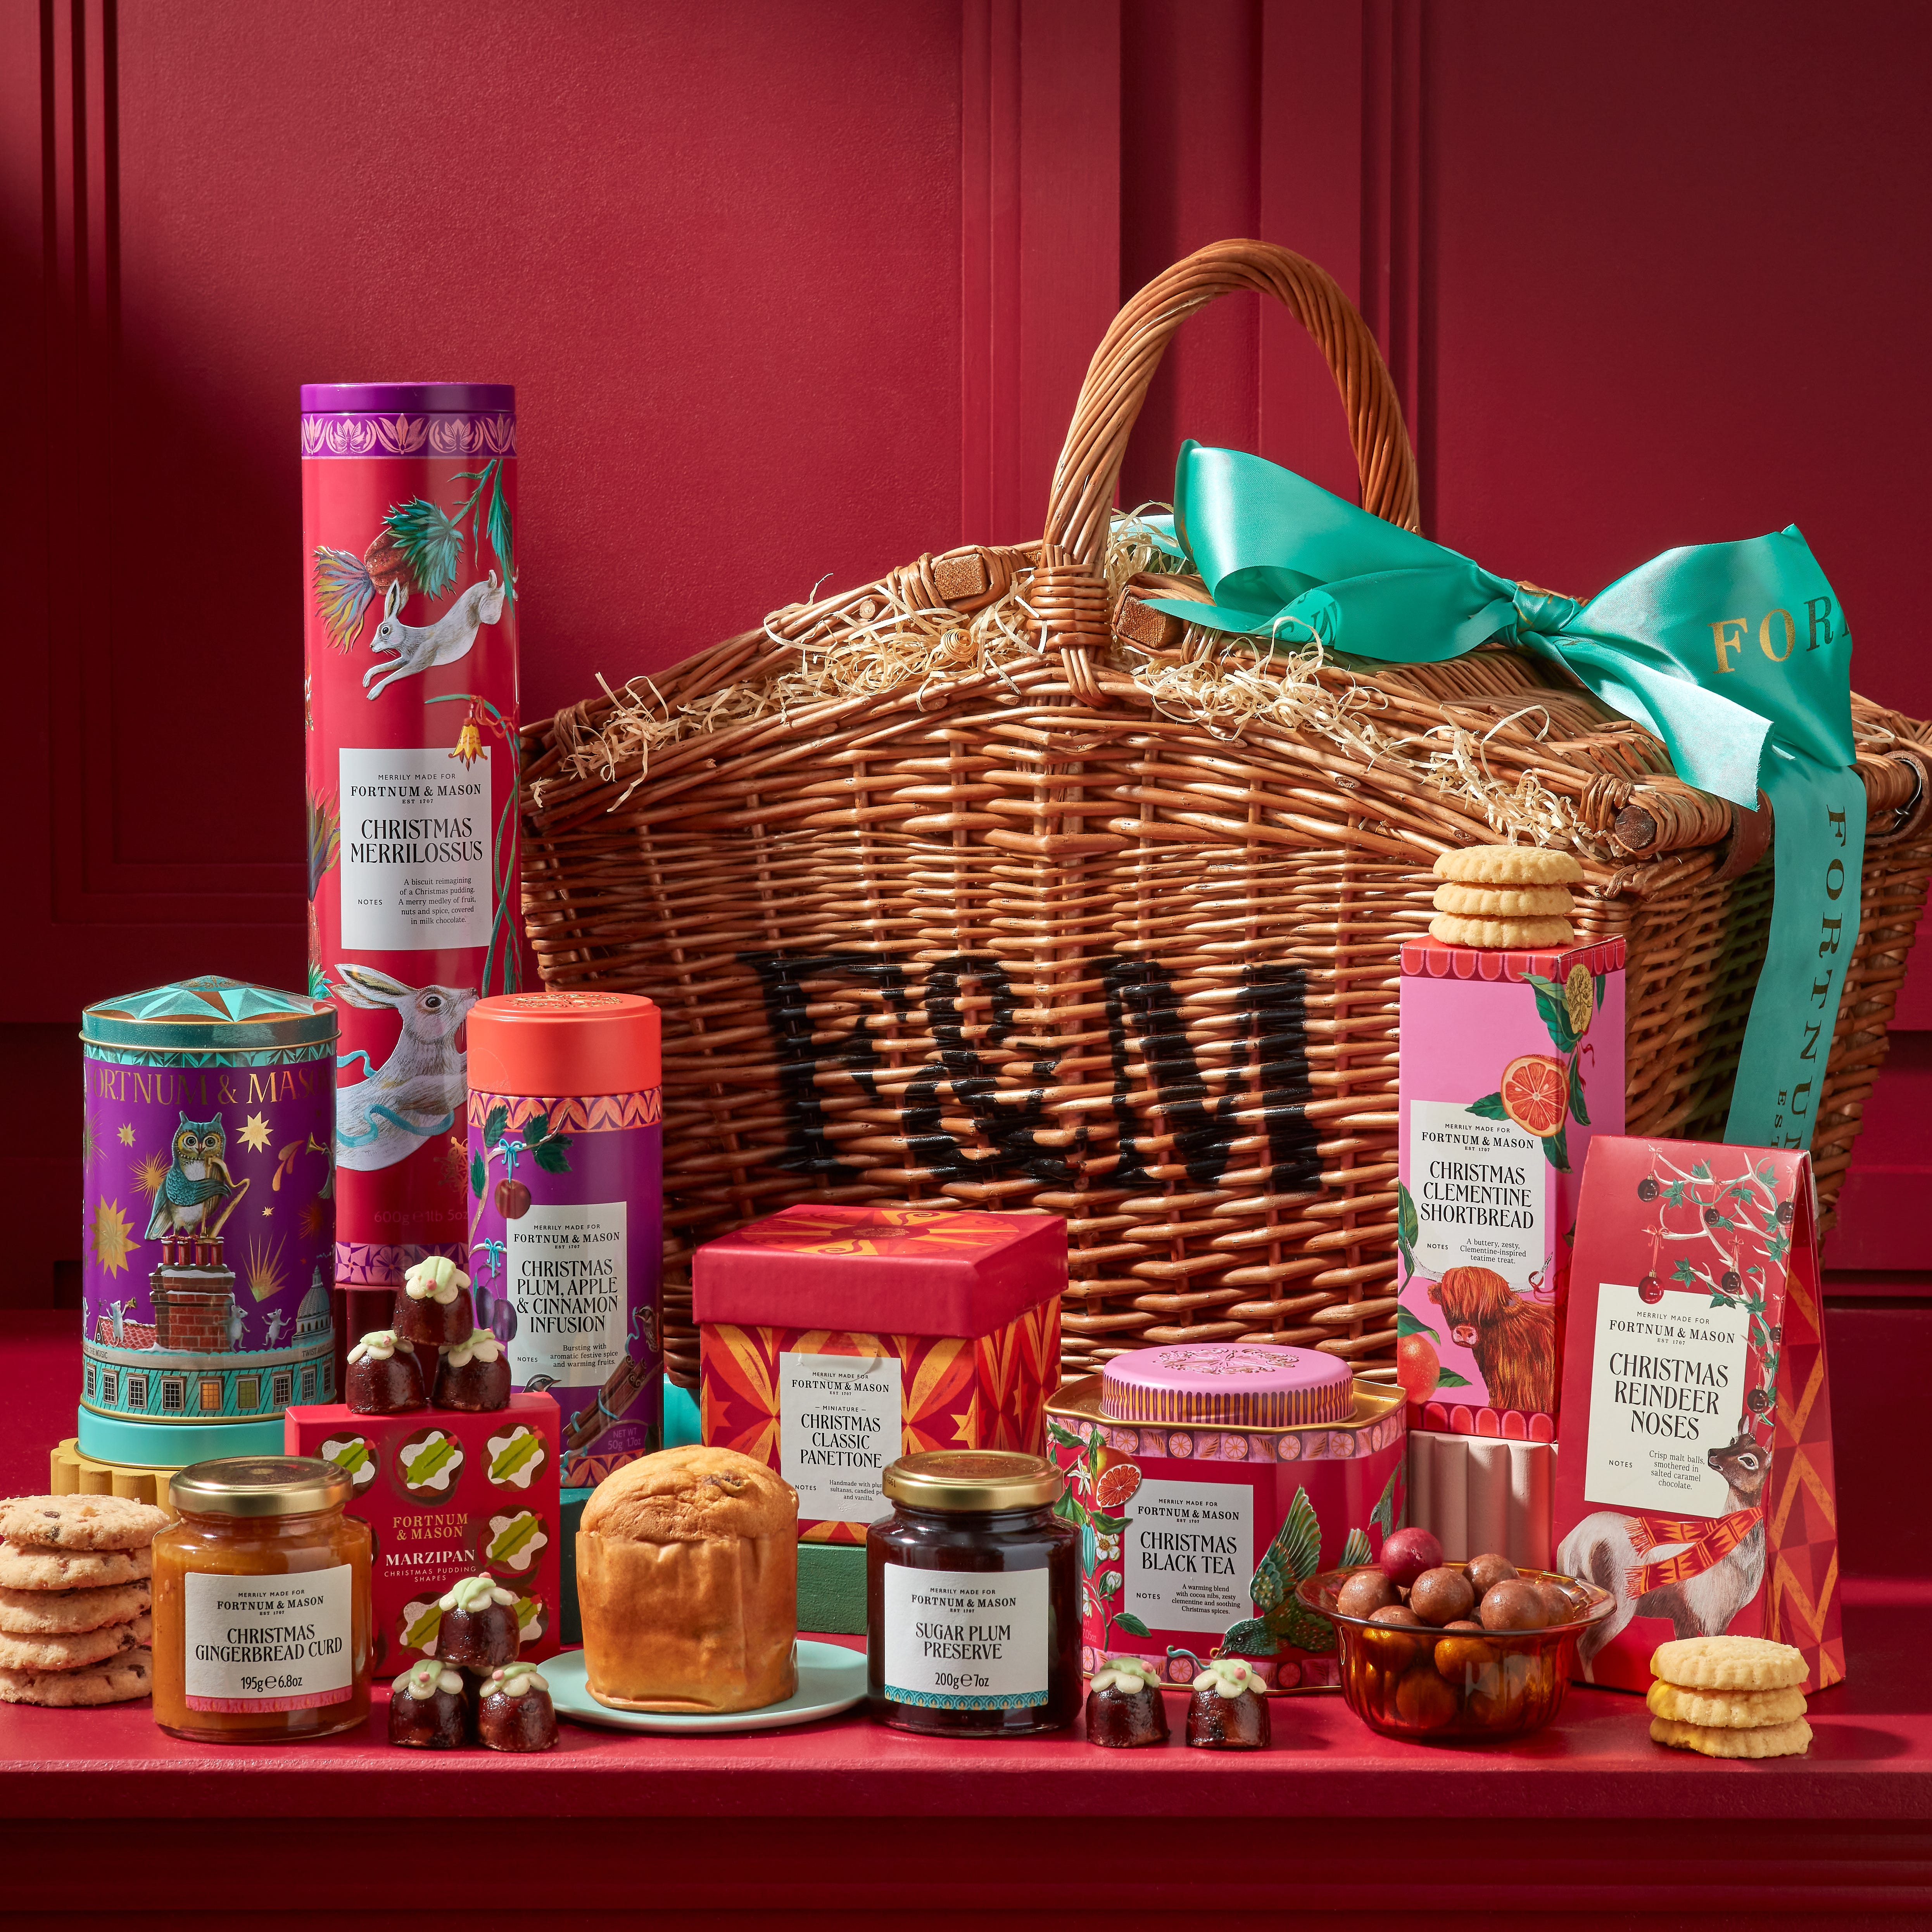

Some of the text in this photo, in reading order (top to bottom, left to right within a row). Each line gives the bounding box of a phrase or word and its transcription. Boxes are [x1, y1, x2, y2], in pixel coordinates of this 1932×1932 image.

[1707, 596, 1851, 674] FOR
[350, 784, 481, 797] FORTNUM & MASON
[361, 817, 472, 839] CHRISTMAS
[351, 841, 483, 863] MERRILOSSUS
[435, 877, 471, 885] reimagining
[450, 886, 475, 895] pudding.
[429, 897, 452, 905] medley
[432, 907, 450, 915] spice,
[748, 952, 1323, 1191] F&M
[87, 1064, 208, 1105] FORTNUM
[218, 1074, 238, 1105] &
[1422, 1132, 1534, 1149] FORTNUM & MASON
[1430, 1160, 1525, 1185] CHRISTMAS
[1423, 1182, 1532, 1207] CLEMENTINE
[1421, 1203, 1533, 1229] SHORTBREAD
[514, 1232, 620, 1243] FORTNUM & MASON
[1474, 1238, 1500, 1248] buttery,
[1460, 1245, 1526, 1257] Clementine-inspired
[522, 1259, 613, 1277] CHRISTMAS
[518, 1277, 618, 1298] PLUM, APPLE
[516, 1295, 618, 1315] & CINNAMON
[1637, 1311, 1667, 1319] MERRILY
[531, 1315, 605, 1333] INFUSION
[1609, 1320, 1735, 1343] FORTNUM & MASON
[603, 1350, 618, 1358] spice
[1610, 1352, 1728, 1388] CHRISTMAS
[792, 1380, 889, 1392] FORTNUM & MASON
[1614, 1380, 1719, 1415] REINDEER
[801, 1413, 881, 1432] CHRISTMAS
[1631, 1410, 1699, 1440] NOSES
[812, 1432, 870, 1450] CLASSIC
[801, 1449, 882, 1468] PANETTONE
[1609, 1460, 1632, 1468] NOTES
[1649, 1450, 1667, 1461] Crisp
[1687, 1455, 1705, 1465] balls,
[1654, 1460, 1699, 1473] smothered in
[1651, 1469, 1701, 1482] salted caramel
[1658, 1479, 1693, 1490] chocolate.
[393, 1513, 468, 1528] FORTNUM
[1138, 1506, 1240, 1520] FORTNUM & MASON
[397, 1526, 463, 1541] & MASON
[1140, 1531, 1237, 1554] CHRISTMAS
[386, 1549, 475, 1566] MARZIPAN
[1142, 1552, 1235, 1575] BLACK TEA
[384, 1569, 433, 1577] CHRISTMAS
[217, 1595, 324, 1610] FORTNUM & MASON
[912, 1594, 1016, 1607] FORTNUM & MASON
[1216, 1601, 1241, 1609] soothing
[227, 1624, 315, 1644] CHRISTMAS
[916, 1622, 1010, 1641] SUGAR PLUM
[195, 1637, 342, 1662] GINGERBREAD CURD
[924, 1641, 1002, 1660] PRESERVE
